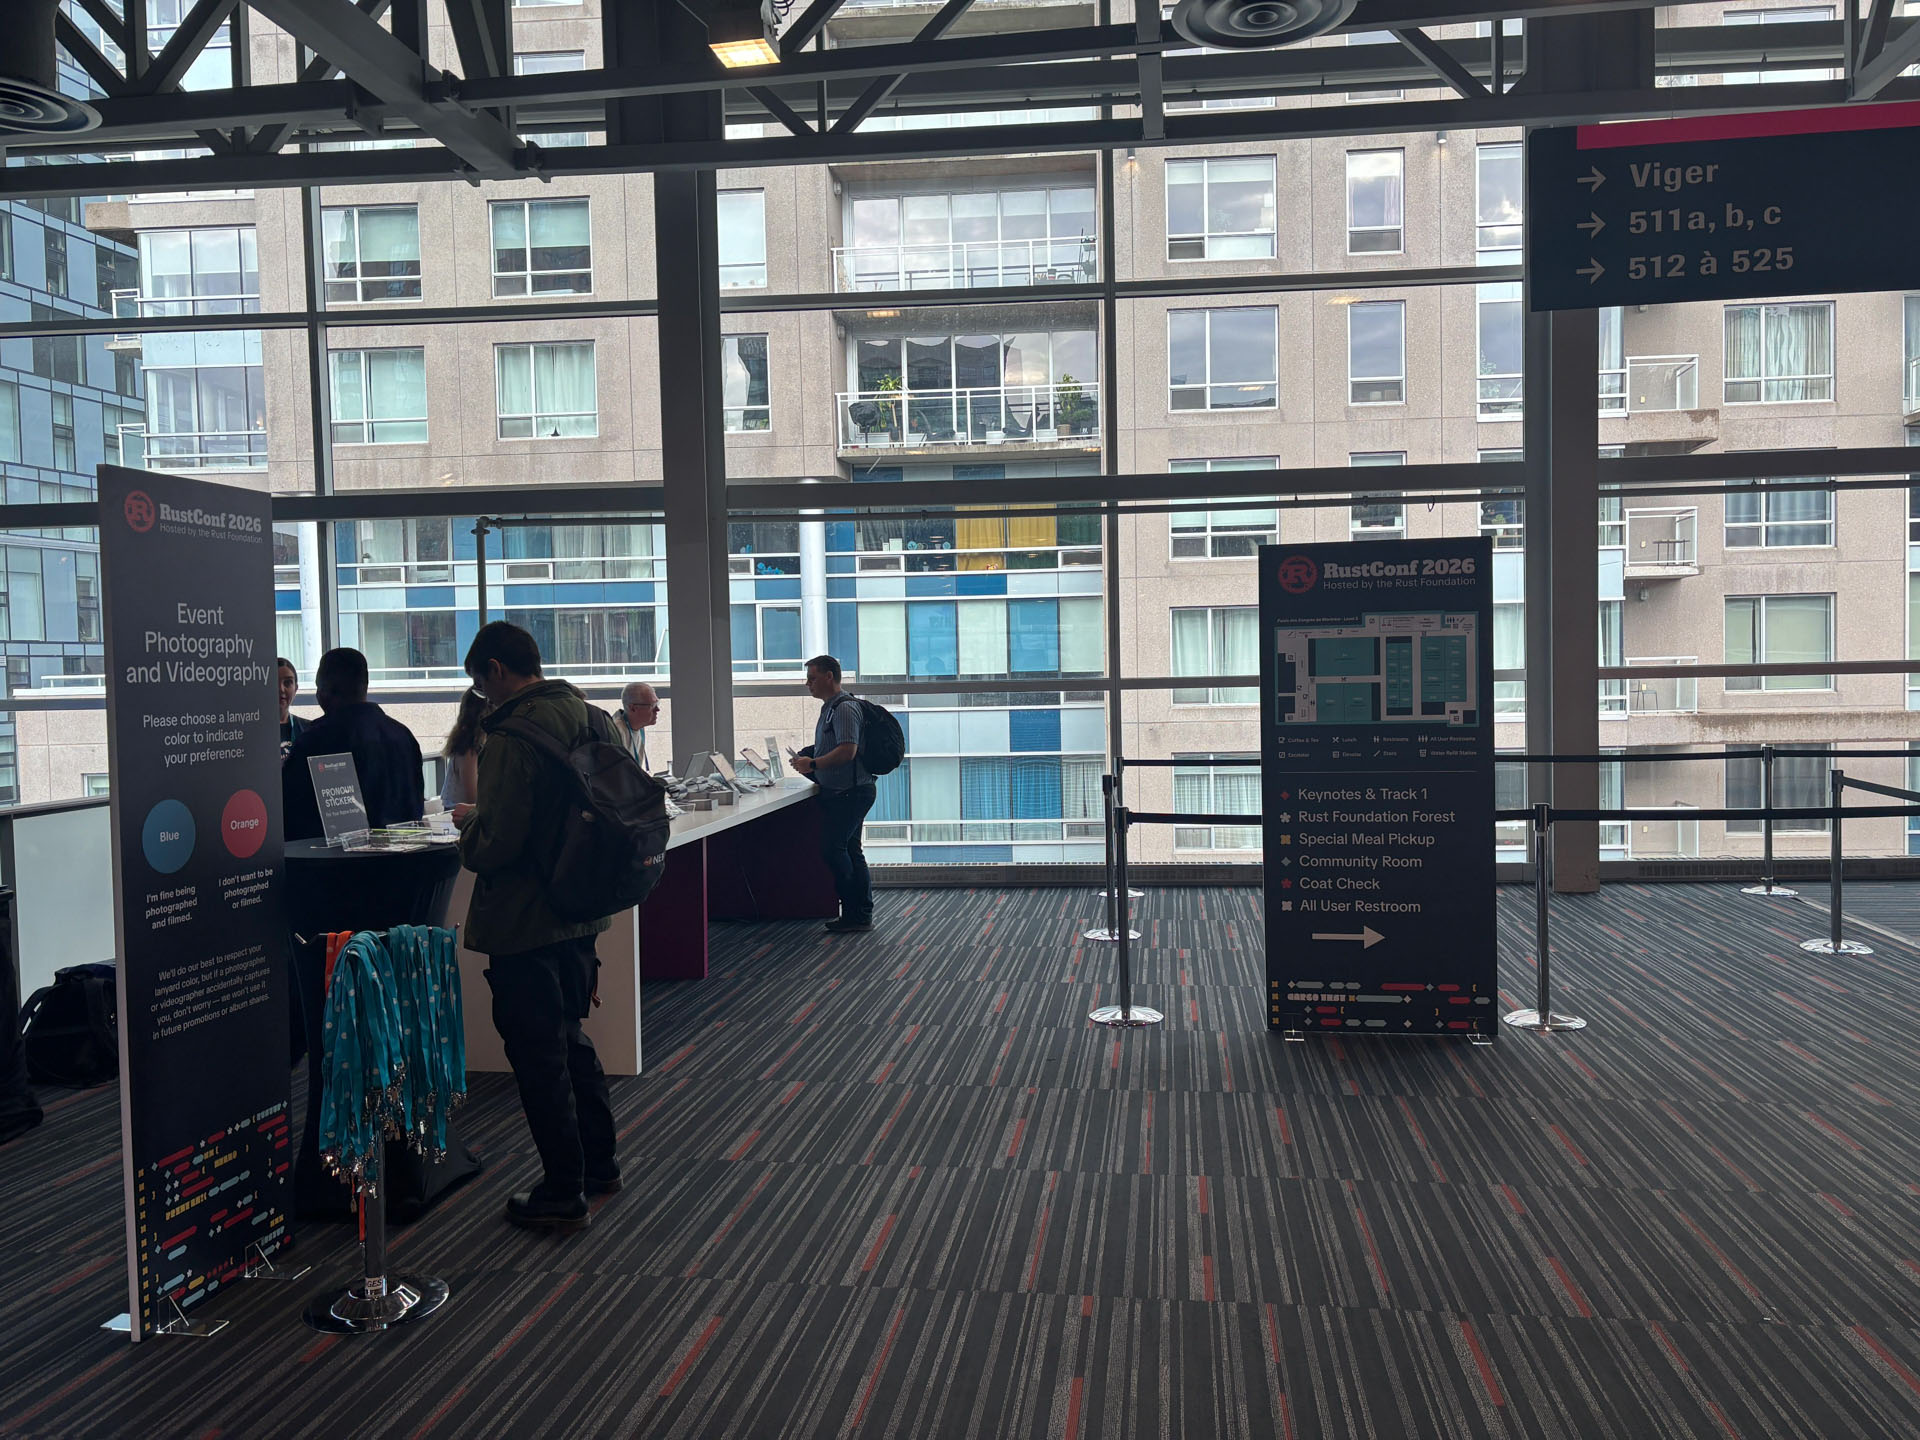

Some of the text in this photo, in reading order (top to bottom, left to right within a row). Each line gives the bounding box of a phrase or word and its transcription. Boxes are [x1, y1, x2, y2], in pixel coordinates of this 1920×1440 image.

[1629, 162, 1719, 193] Viger
[1629, 203, 1782, 234] 511a, b, c
[1628, 246, 1794, 280] 512 à 525
[160, 503, 262, 534] RustConf 2026
[160, 523, 263, 544] Hosted by the Rust Foundation
[1323, 558, 1476, 579] RustConf 2026
[1323, 577, 1476, 592] Hosted by the Rust Foundation
[177, 602, 224, 625] Event
[145, 631, 254, 660] Photography
[126, 661, 270, 687] and Videography
[143, 709, 260, 728] Please choose a lanyard
[164, 728, 244, 746] color to indicate
[164, 746, 245, 768] your preference:
[321, 785, 354, 797] PRONOUN
[1298, 788, 1428, 802] Keynotes & Track 1
[230, 816, 259, 831] Orange
[1298, 810, 1456, 823] Rust Foundation Forest
[160, 830, 180, 843] Blue
[1298, 833, 1436, 848] Special Meal Pickup
[1298, 855, 1423, 870] Community Room
[218, 868, 273, 888] I don't want to be
[1299, 877, 1381, 890] Coat Check
[146, 886, 196, 904] I'm fine being
[224, 881, 270, 901] photographed
[145, 898, 198, 920] photographed
[231, 896, 262, 910] or filmed.
[1300, 900, 1421, 913] All User Restroom
[151, 913, 193, 930] and filmed.
[158, 944, 263, 983] We'll do our best to respect your
[155, 956, 267, 997] lanyard color, but if a photographer
[150, 967, 271, 1014] or videographer accidentally captures
[157, 1014, 173, 1027] you,
[173, 1004, 193, 1019] don't
[192, 999, 212, 1014] worry
[221, 993, 232, 1003] we
[232, 987, 250, 1001] won't
[250, 983, 262, 994] use
[261, 980, 267, 990] it
[152, 993, 271, 1040] in future promotions or album shares.
